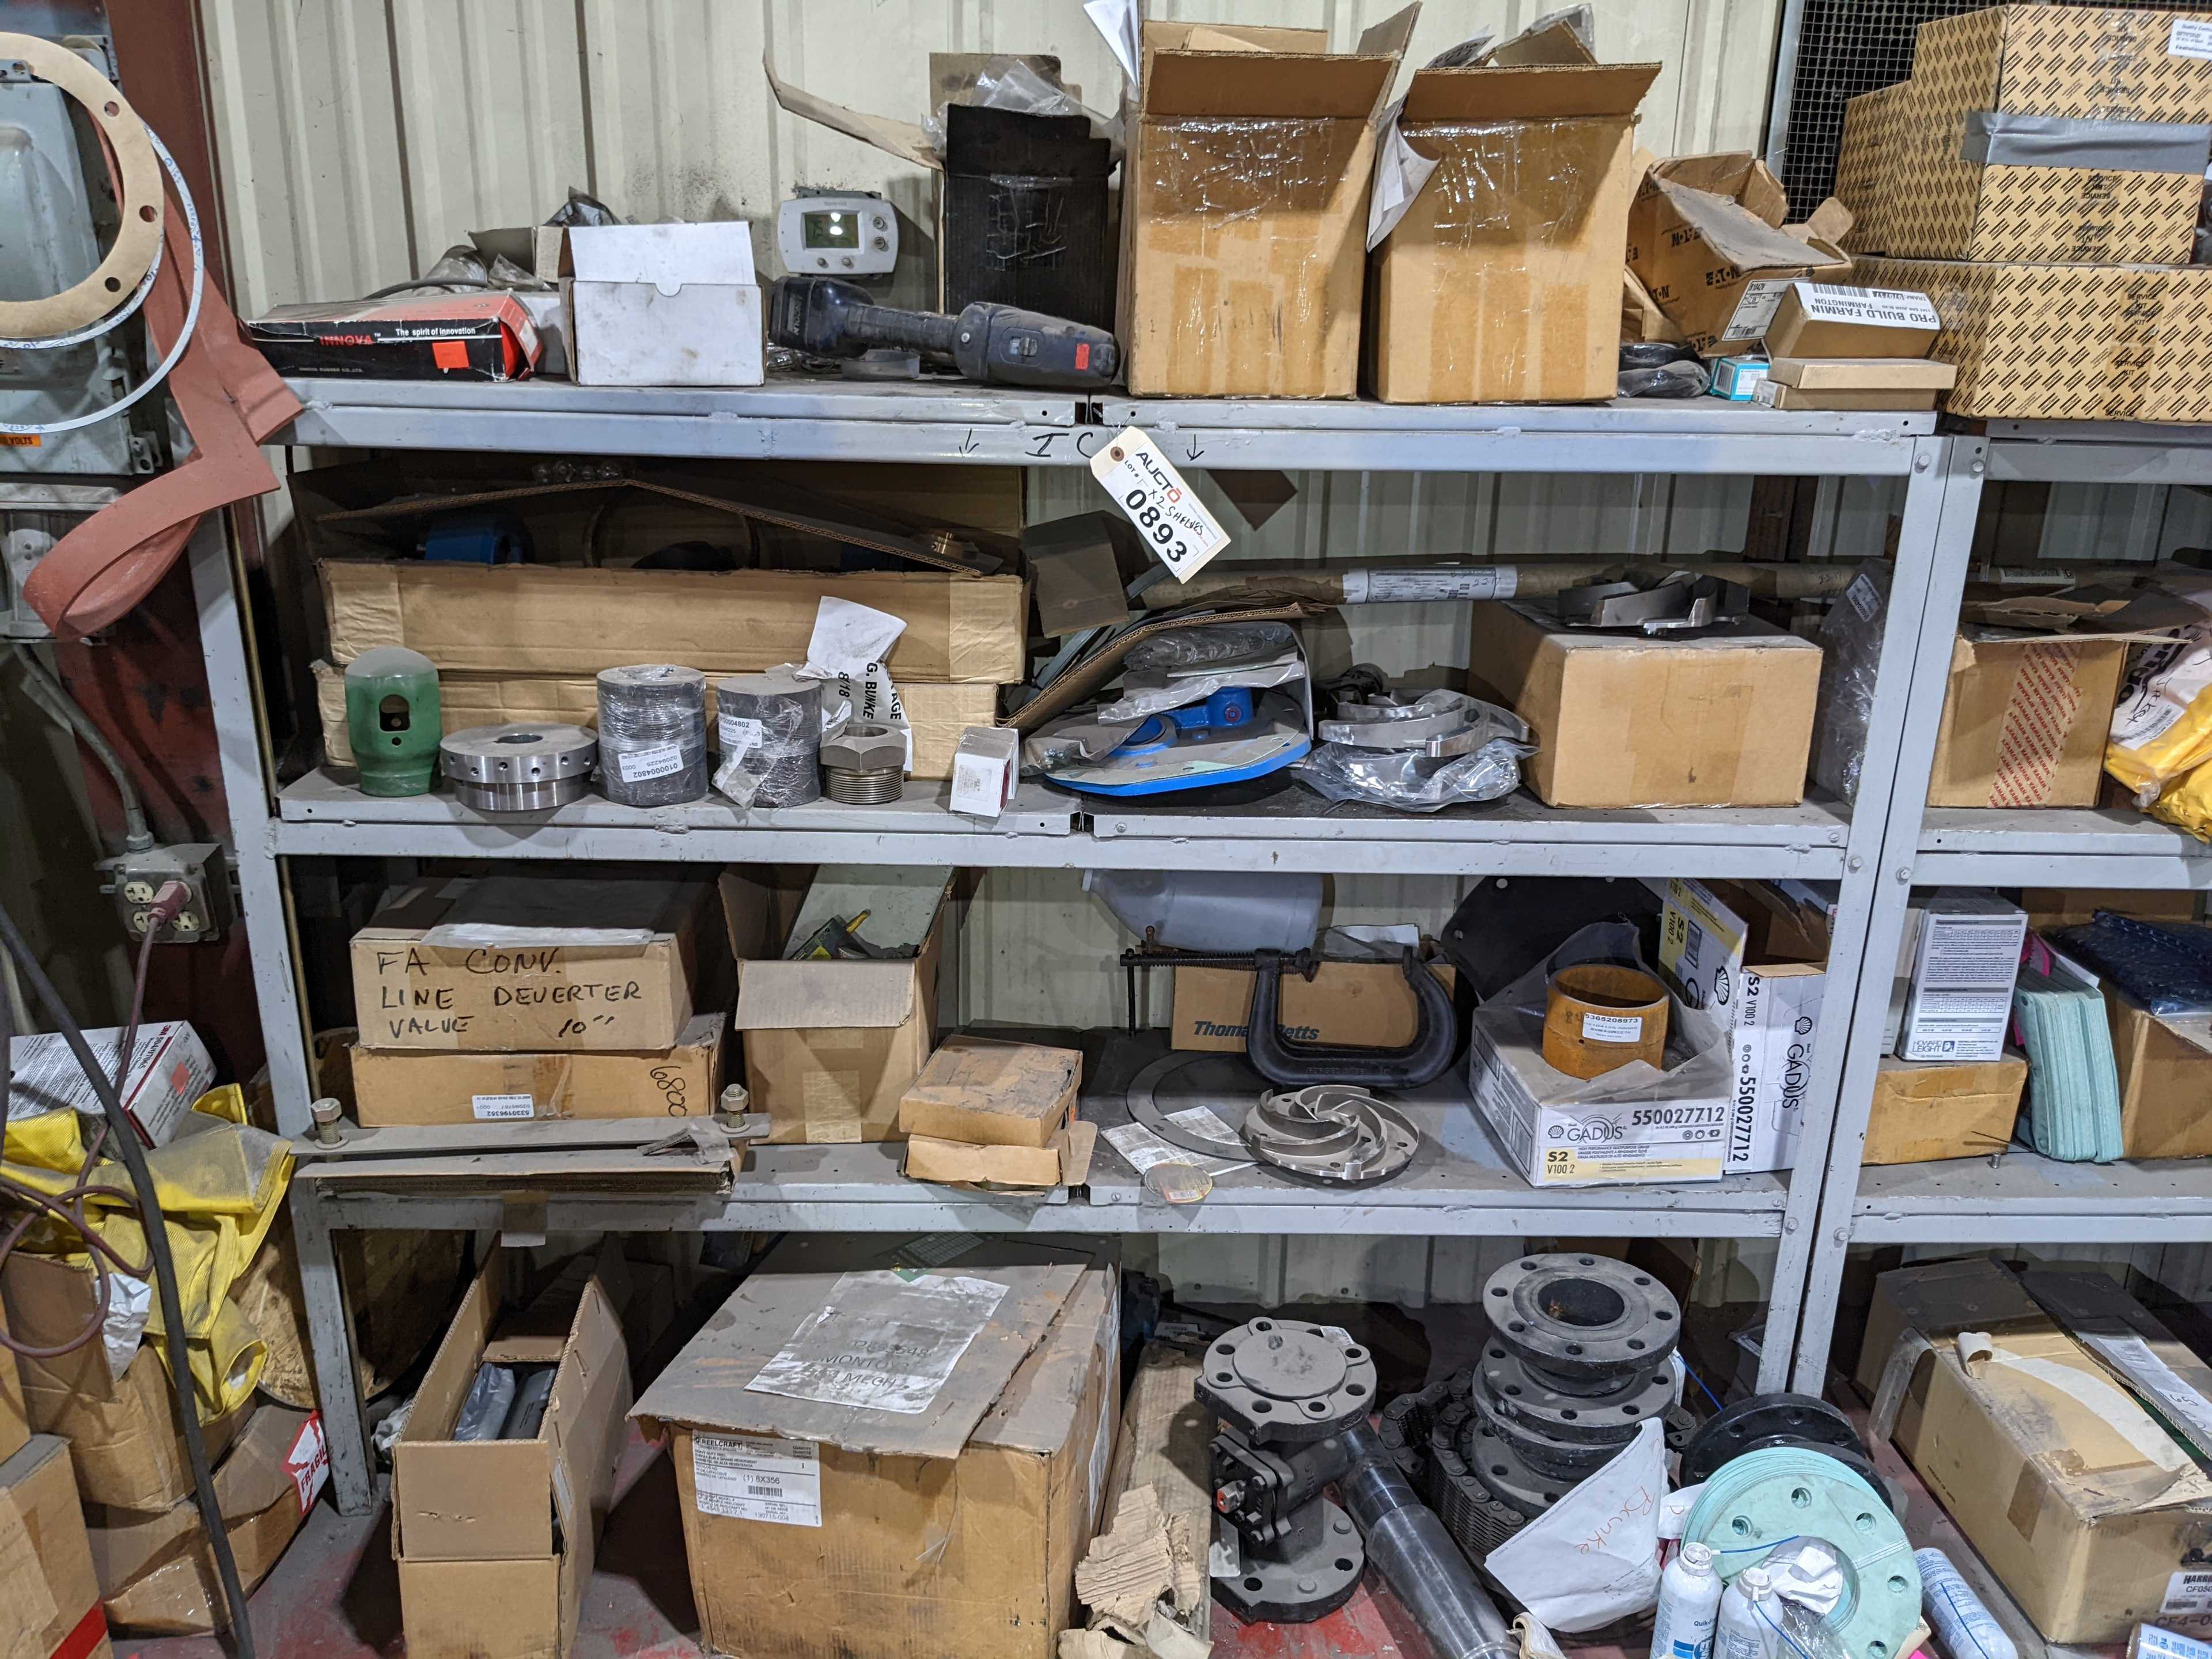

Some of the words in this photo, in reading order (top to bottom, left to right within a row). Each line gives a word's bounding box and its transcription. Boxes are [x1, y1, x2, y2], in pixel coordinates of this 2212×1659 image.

[1810, 304, 1862, 317] FARMIN
[1815, 298, 1872, 309] FARMINGTON
[1866, 309, 1905, 320] BUILD
[1910, 313, 1937, 323] PRO
[396, 328, 409, 336] The
[412, 328, 430, 337] spirit
[320, 335, 373, 346] INNOVA
[10, 435, 33, 445] VOLTS
[1124, 460, 1136, 473] LOT
[1126, 489, 1187, 563] 0893
[863, 681, 877, 719] BUNKE
[632, 763, 678, 778] 0100004802
[376, 951, 431, 975] FA
[465, 948, 563, 975] CONV.
[1747, 976, 1760, 997] S2
[381, 986, 455, 1010] LINE
[1744, 999, 1757, 1020] V100
[1585, 1014, 1638, 1023] 5365208973
[159, 1025, 171, 1036] 3M
[1194, 1021, 1248, 1037] Thoma
[1782, 1044, 1804, 1109] GADUS
[1631, 1107, 1725, 1126] 550027712
[1732, 1076, 1756, 1161] 550027712
[1567, 1125, 1623, 1141] GADUS
[1547, 1152, 1568, 1162] S2
[1547, 1164, 1567, 1174] V100
[1570, 1164, 1575, 1174] 2
[702, 1439, 741, 1449] REELCRAFT
[301, 1442, 328, 1494] FRAGIL
[743, 1474, 753, 1483] (1)
[1576, 1485, 1657, 1555] Bunke
